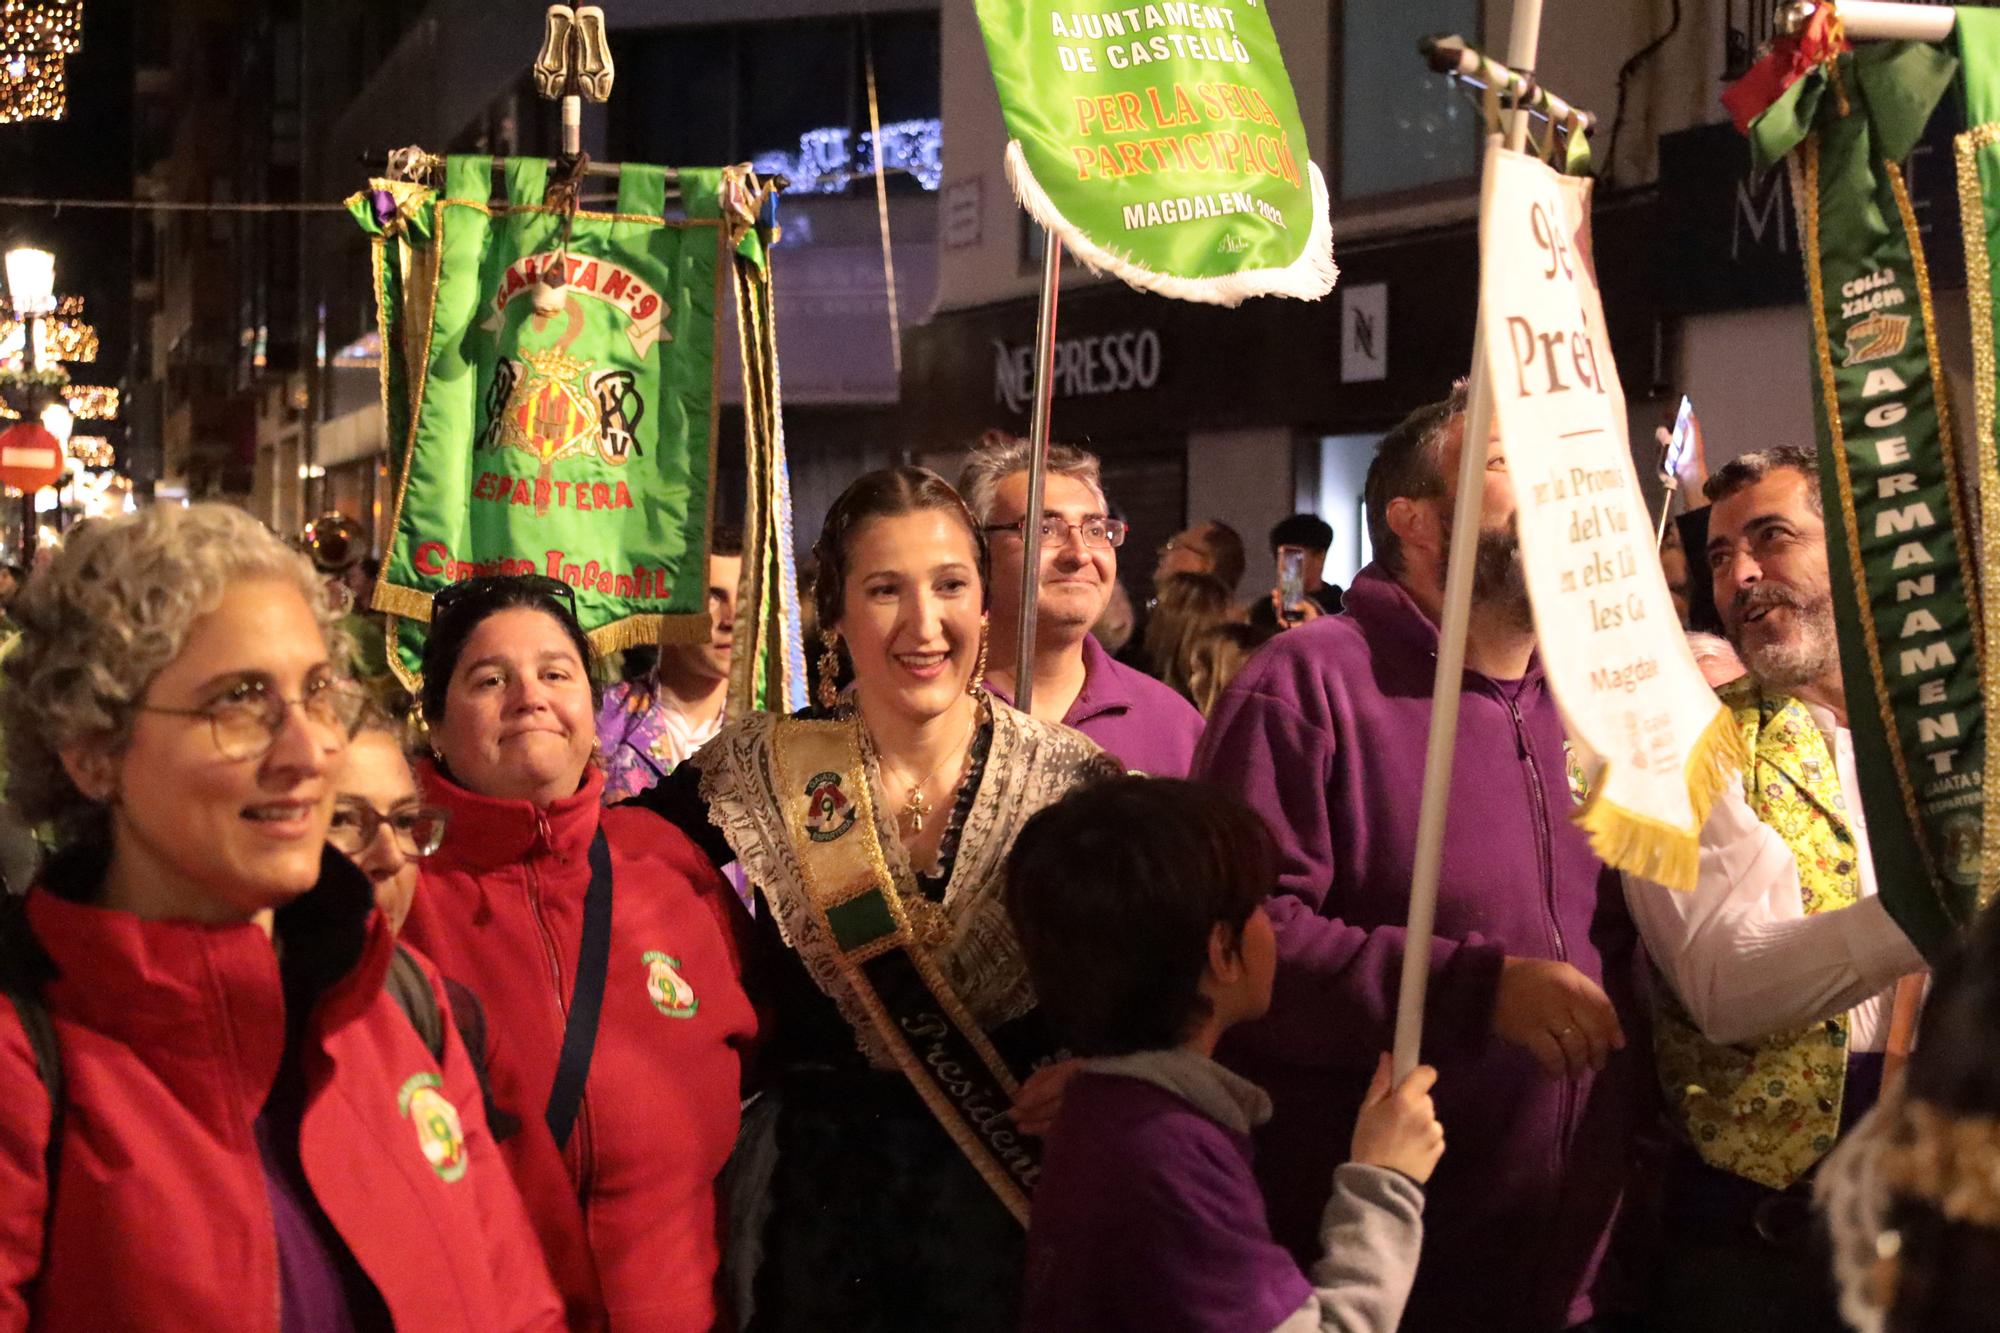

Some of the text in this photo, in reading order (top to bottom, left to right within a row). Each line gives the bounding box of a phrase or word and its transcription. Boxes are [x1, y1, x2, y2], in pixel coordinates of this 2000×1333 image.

[1051, 2, 1236, 40] AJUNTAMENT
[1057, 33, 1251, 73] DE CASTELLÓ
[1075, 81, 1281, 136] PER LA SEUA
[1072, 131, 1302, 189] PARTICIPACIÓ
[497, 255, 598, 311] GAITA
[994, 329, 1160, 414] NEPRESSO
[473, 472, 635, 511] ESPARTERA
[1570, 505, 1602, 544] del
[1583, 551, 1614, 588] els
[1861, 367, 1961, 775] AGERMANAMENT
[1589, 599, 1624, 632] les
[821, 797, 834, 822] 9
[658, 976, 677, 1006] 9
[429, 1115, 455, 1160] 9
